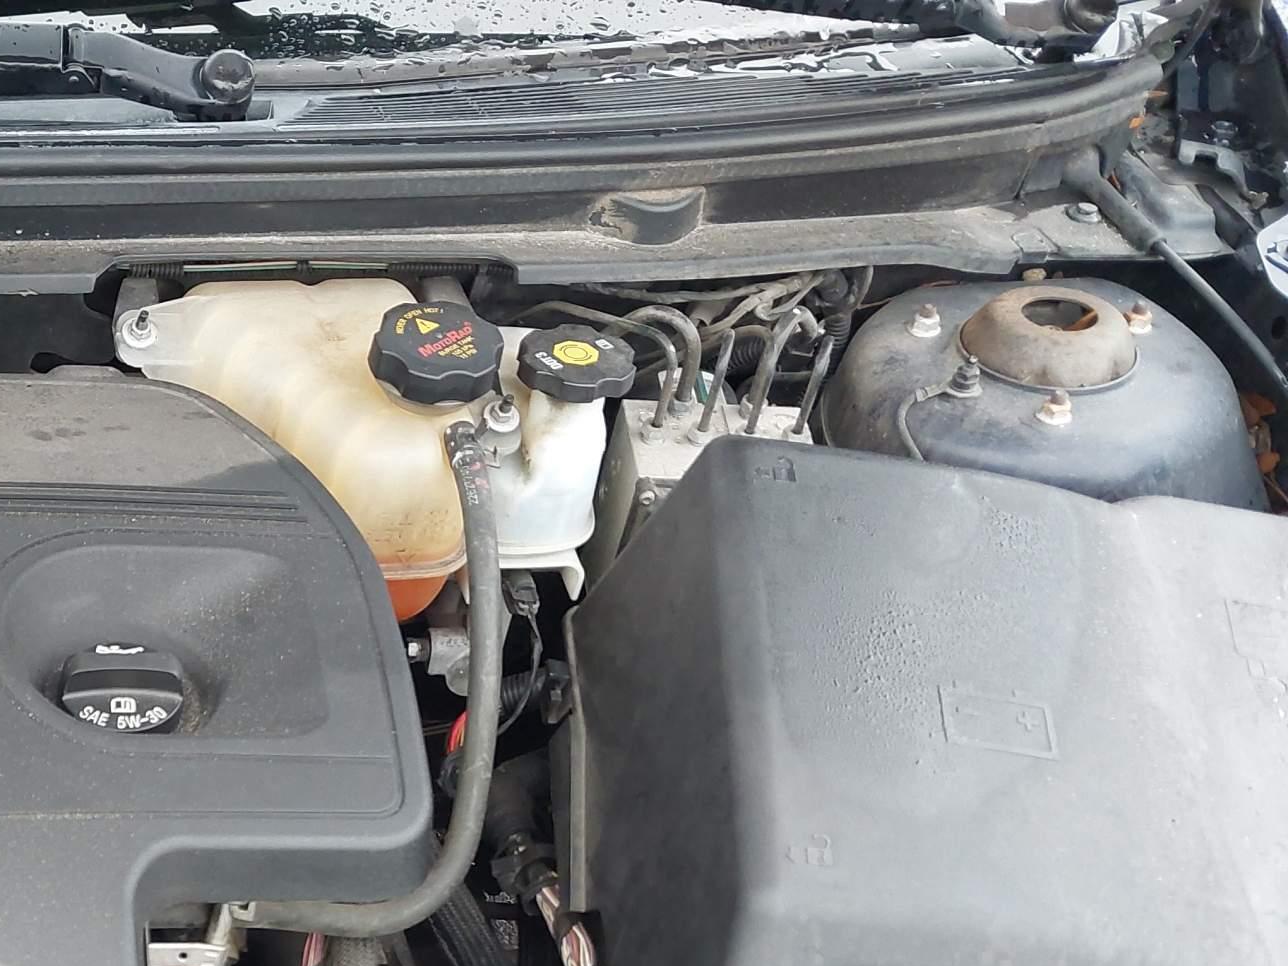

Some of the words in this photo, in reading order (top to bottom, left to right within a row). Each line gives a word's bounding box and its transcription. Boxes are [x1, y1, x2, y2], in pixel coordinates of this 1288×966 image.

[403, 309, 423, 320] OPEN
[79, 705, 111, 727] SAE
[116, 706, 168, 729] 5W-30
